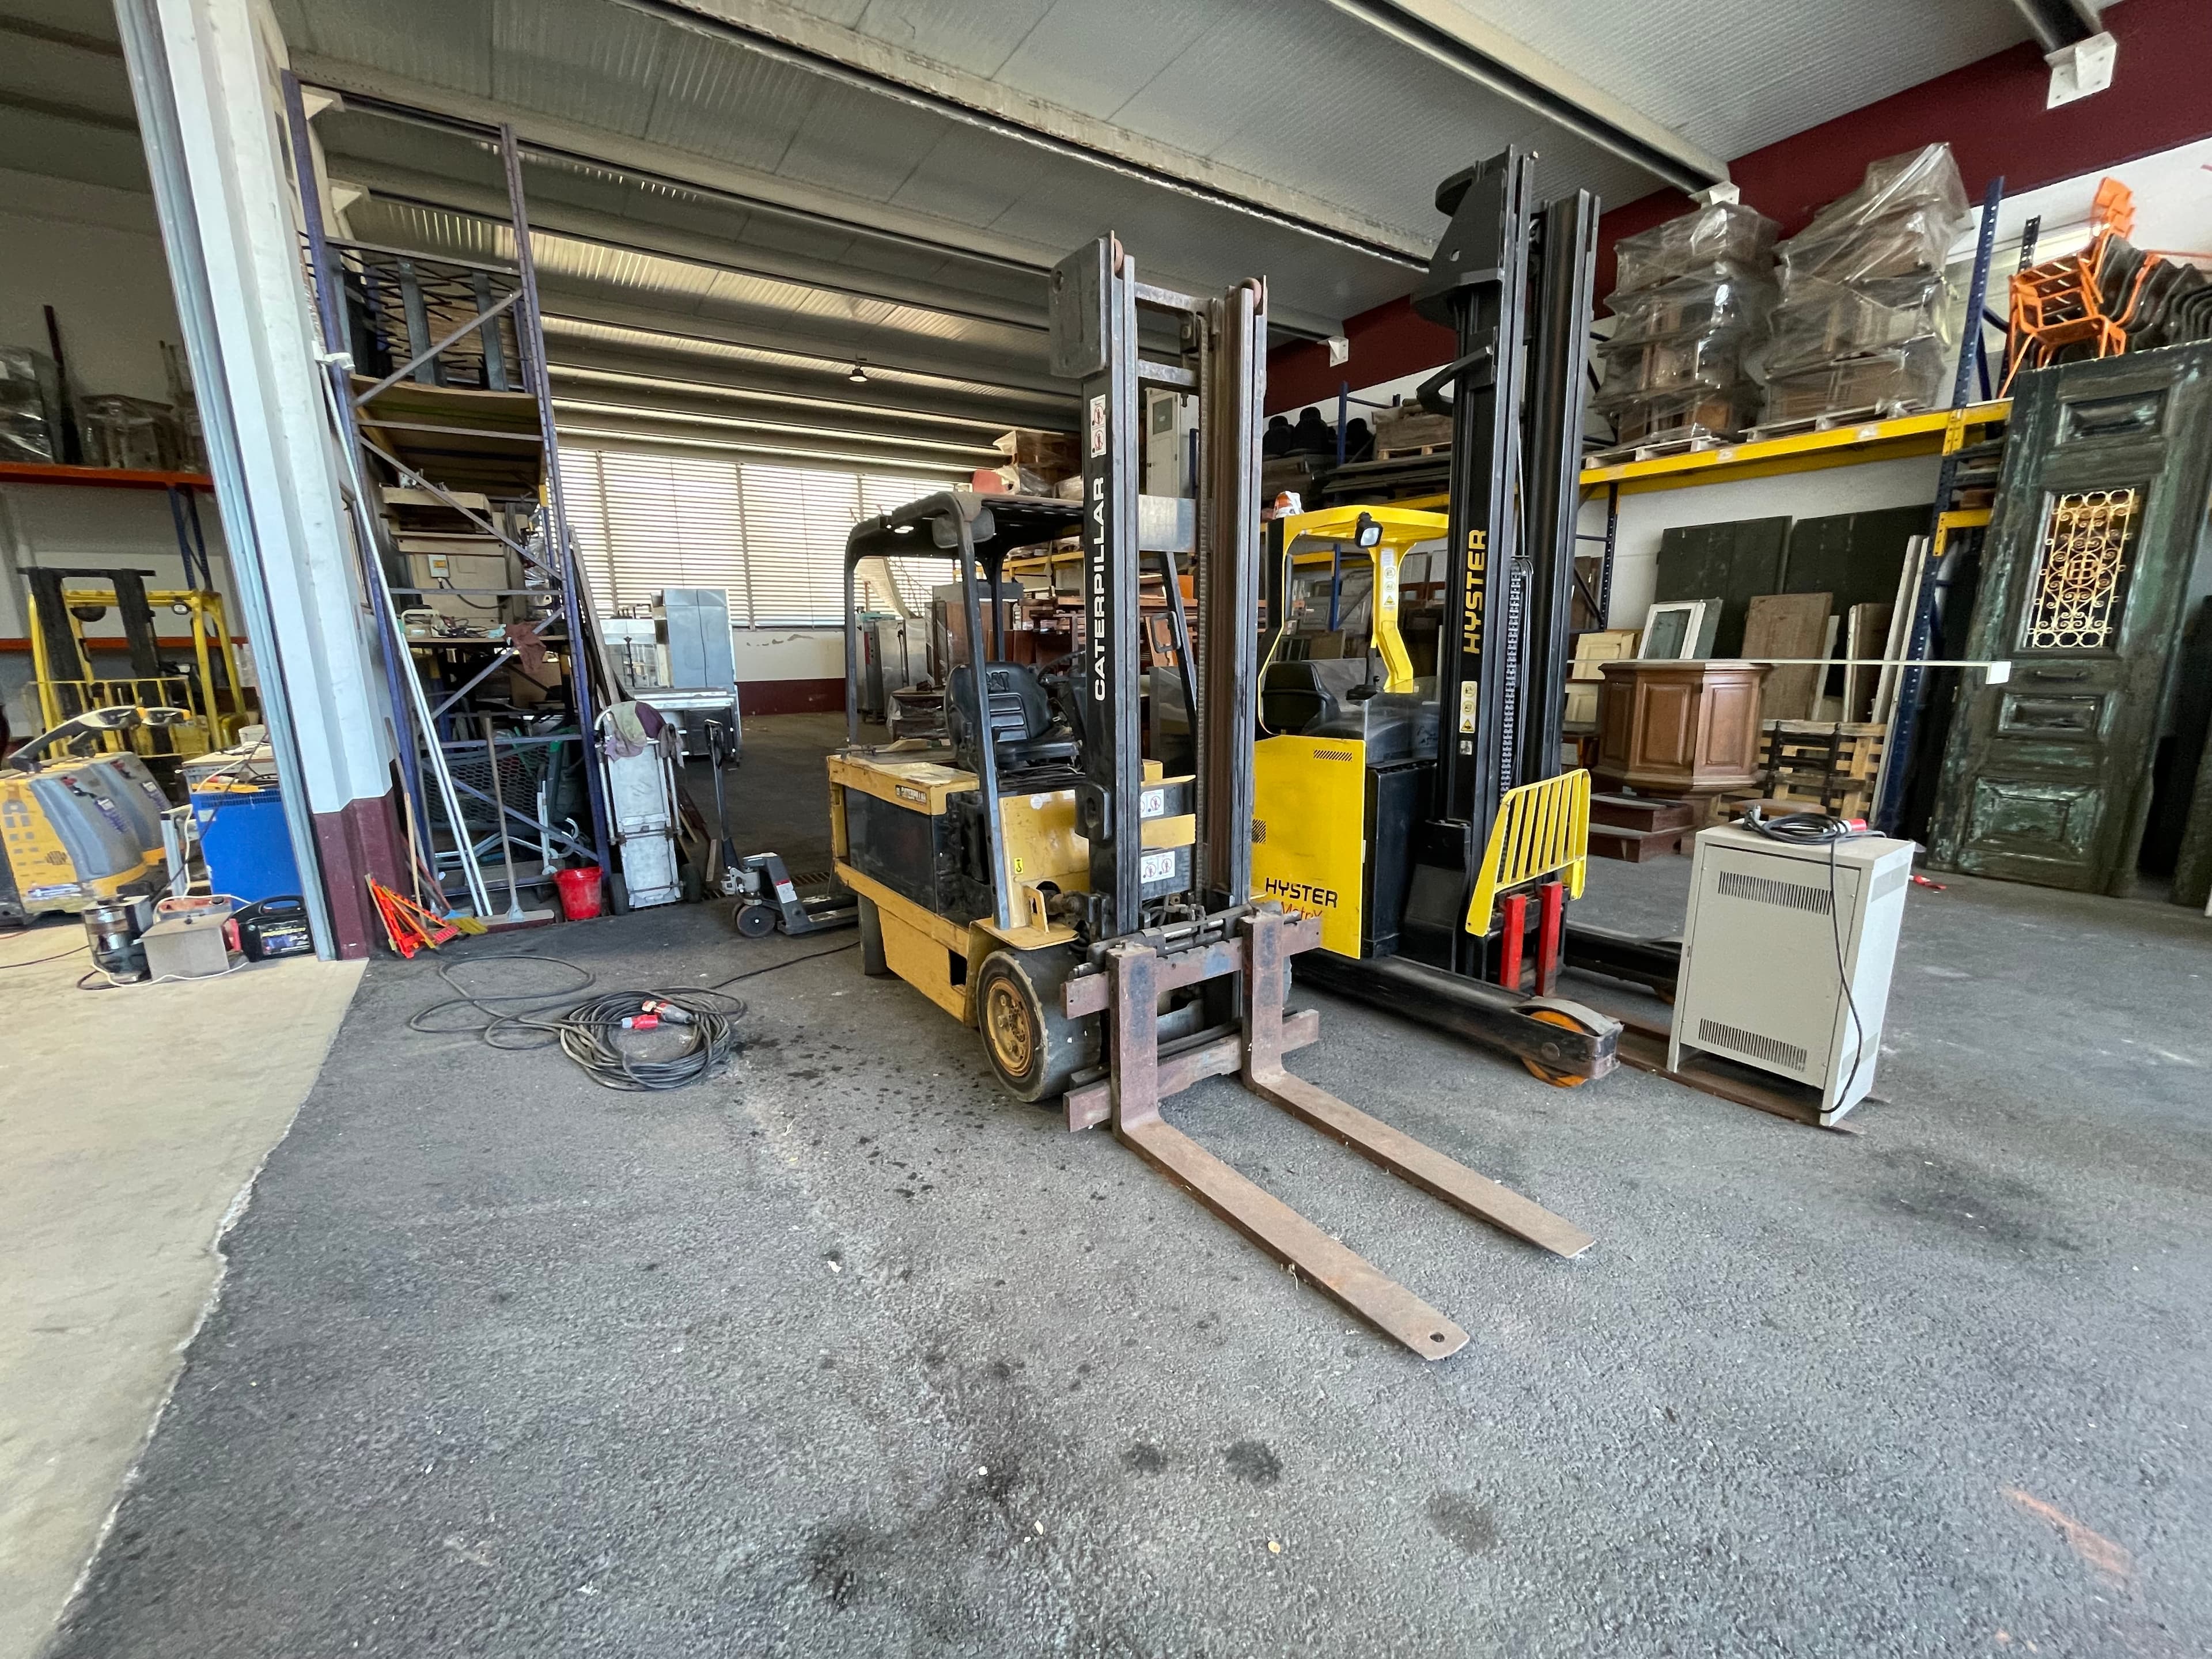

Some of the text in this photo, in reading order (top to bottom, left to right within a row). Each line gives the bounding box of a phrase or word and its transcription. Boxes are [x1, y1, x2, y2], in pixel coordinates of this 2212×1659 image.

[1093, 477, 1105, 701] CATERPILLAR
[1463, 529, 1487, 654] HYSTER
[1266, 877, 1338, 908] HYSTER
